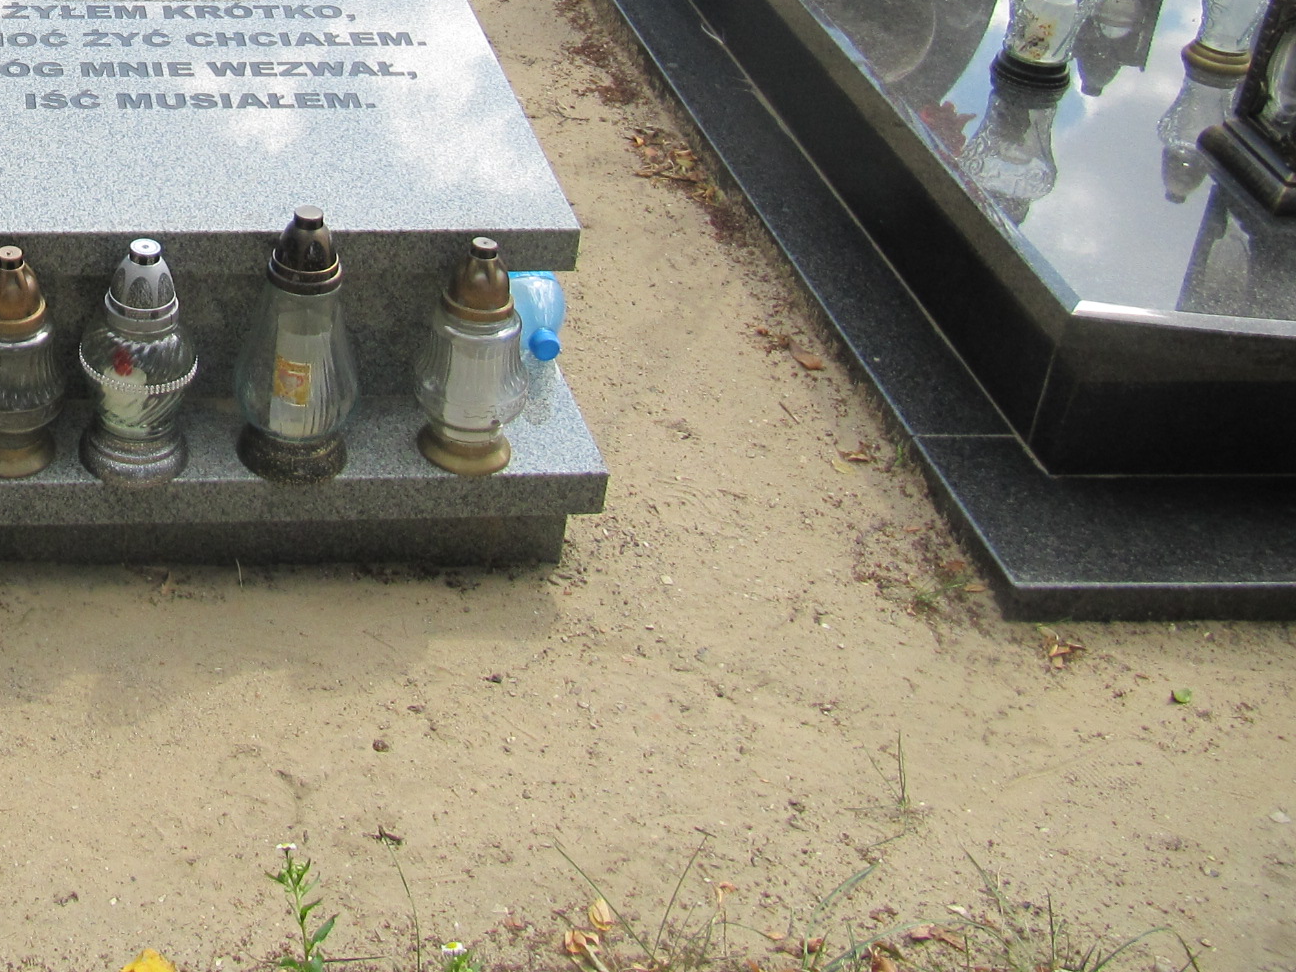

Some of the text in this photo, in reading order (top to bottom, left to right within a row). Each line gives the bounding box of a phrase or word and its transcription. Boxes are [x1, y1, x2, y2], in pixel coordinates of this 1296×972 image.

[2, 2, 356, 22] ŻYŁEM KRÓTKO,
[81, 30, 171, 48] ŻYĆ
[185, 31, 428, 48] CHCIAŁEM.
[80, 61, 195, 78] MNIE
[205, 60, 418, 81] WEZWAŁ,
[24, 89, 377, 110] IŚĆ MUSIAŁEM.
